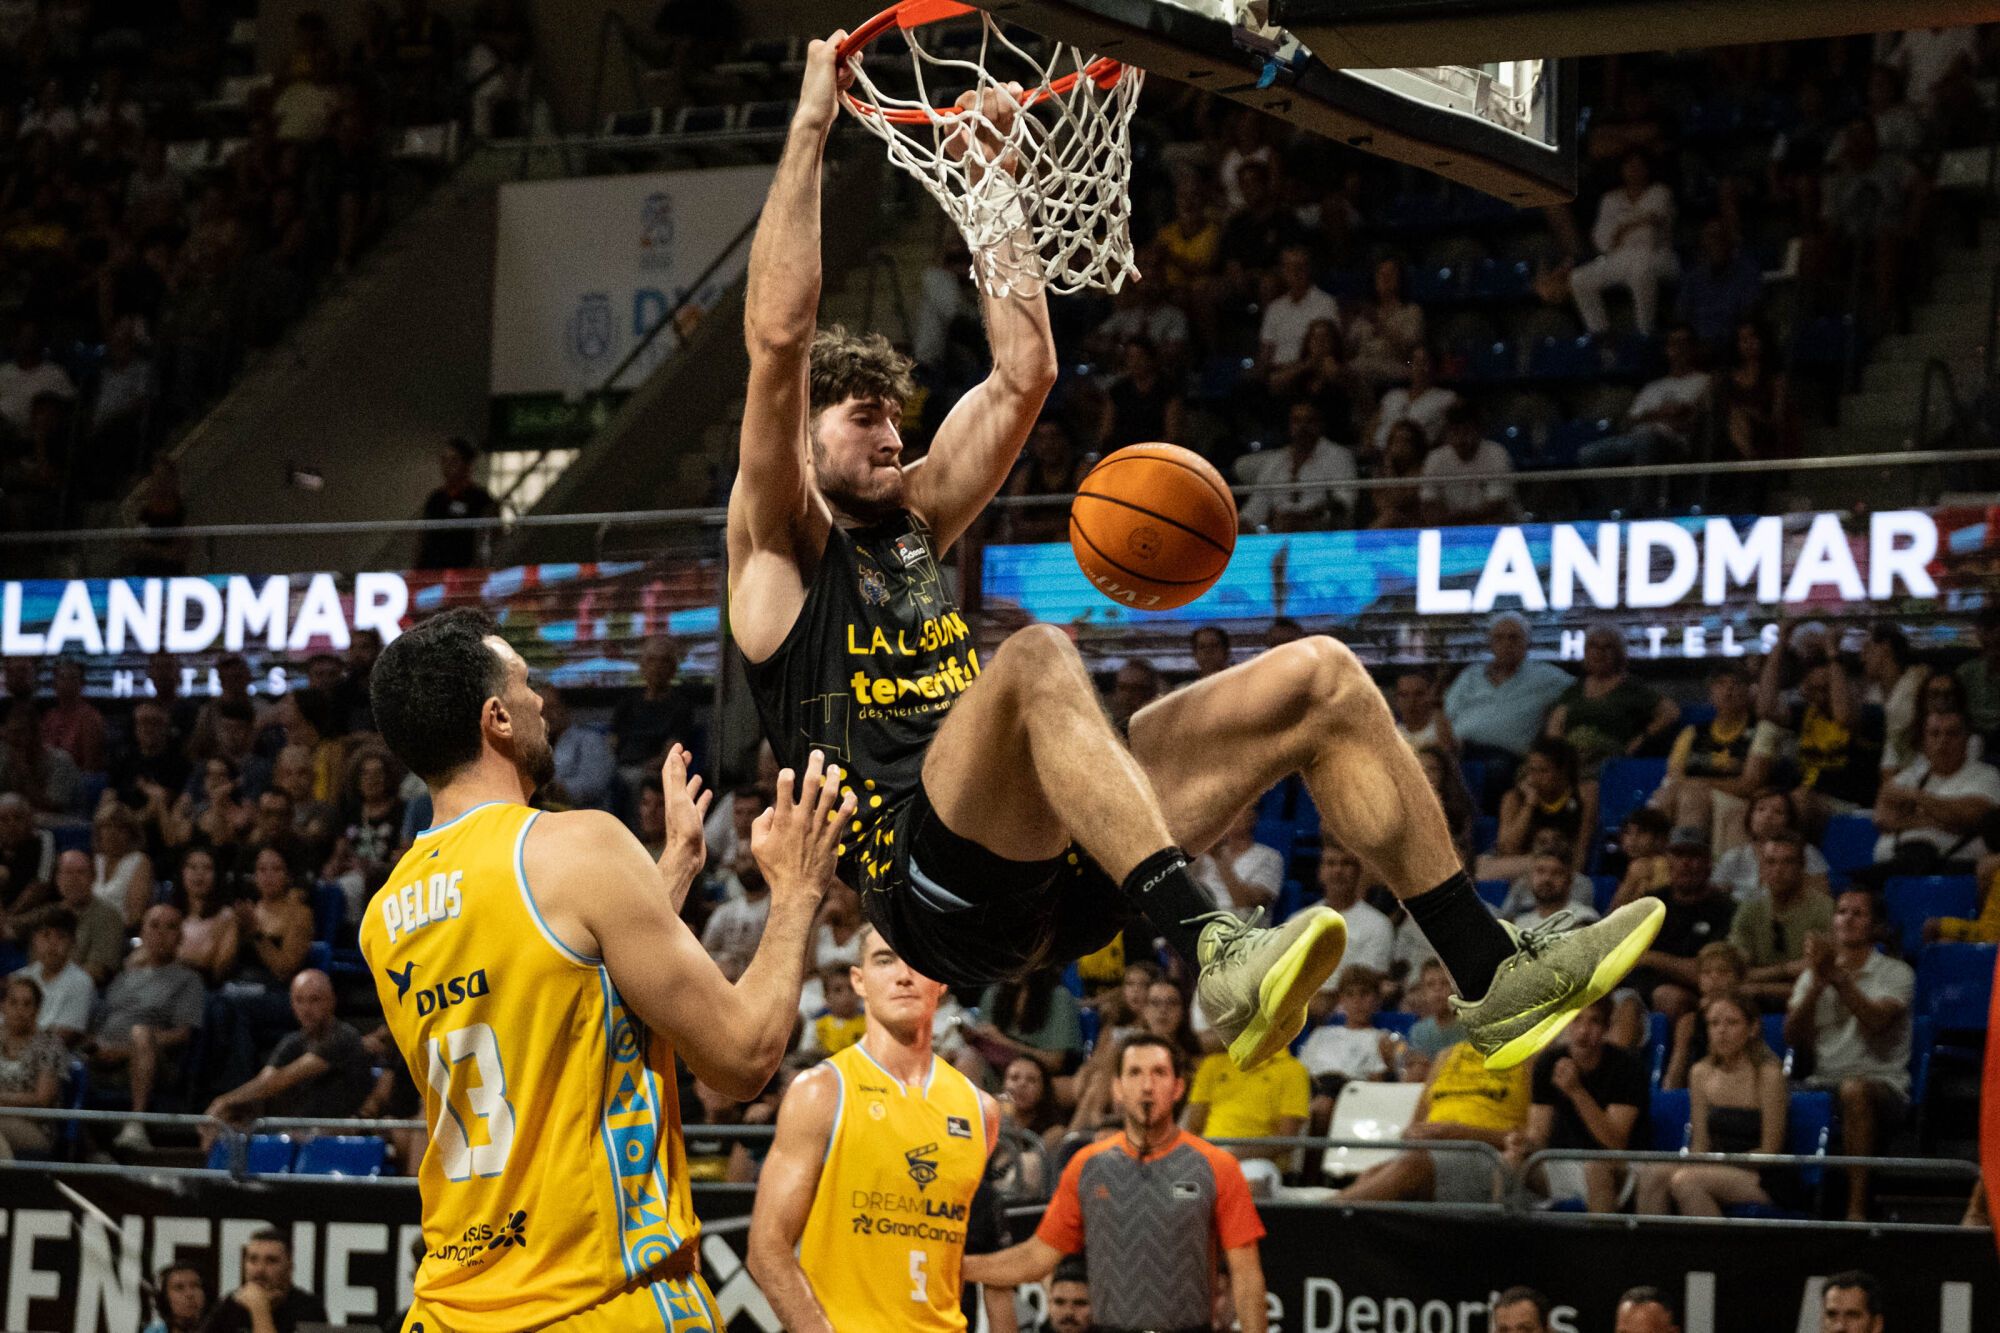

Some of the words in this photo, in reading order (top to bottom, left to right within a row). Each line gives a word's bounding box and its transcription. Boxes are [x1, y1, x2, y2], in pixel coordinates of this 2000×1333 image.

[1415, 509, 1940, 615] LANDMAR
[1, 571, 410, 656] LANDMAR
[847, 623, 894, 655] LA
[1560, 622, 1780, 662] HTELS
[381, 869, 463, 944] PELOS
[426, 1022, 516, 1183] 13
[909, 1250, 928, 1302] 5
